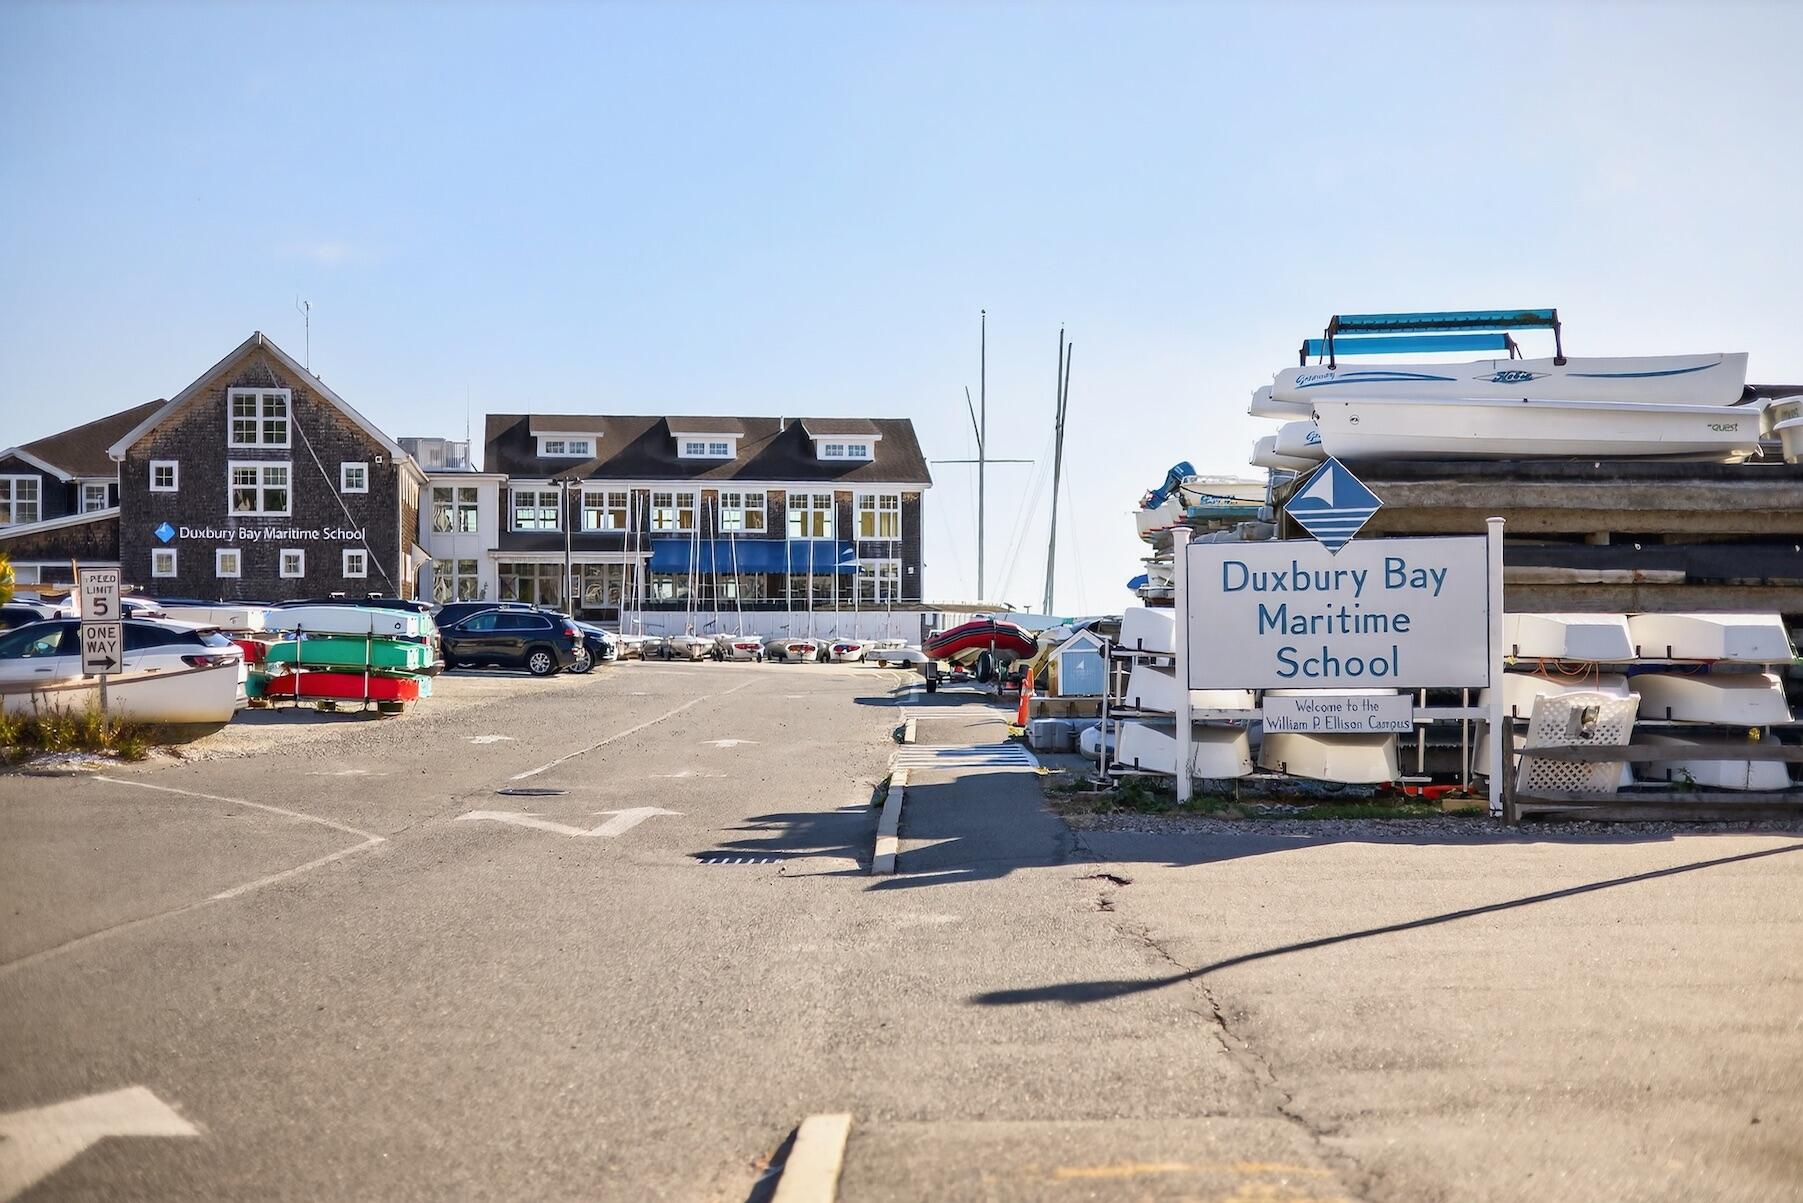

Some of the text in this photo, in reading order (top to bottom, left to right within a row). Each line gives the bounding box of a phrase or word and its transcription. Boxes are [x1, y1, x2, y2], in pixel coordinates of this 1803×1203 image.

[179, 526, 366, 542] Duxbury Bay Maritime School
[1222, 557, 1448, 598] Duxbury Bay
[86, 586, 114, 595] LIMIT
[93, 597, 108, 616] 5
[1258, 602, 1411, 635] Maritime
[87, 627, 116, 639] ONE
[86, 640, 117, 653] WAY
[1276, 645, 1398, 678] School
[1295, 699, 1379, 712] Welcome to the
[1266, 716, 1308, 731] William
[1325, 715, 1363, 729] Ellison
[1368, 715, 1410, 731] Campus
